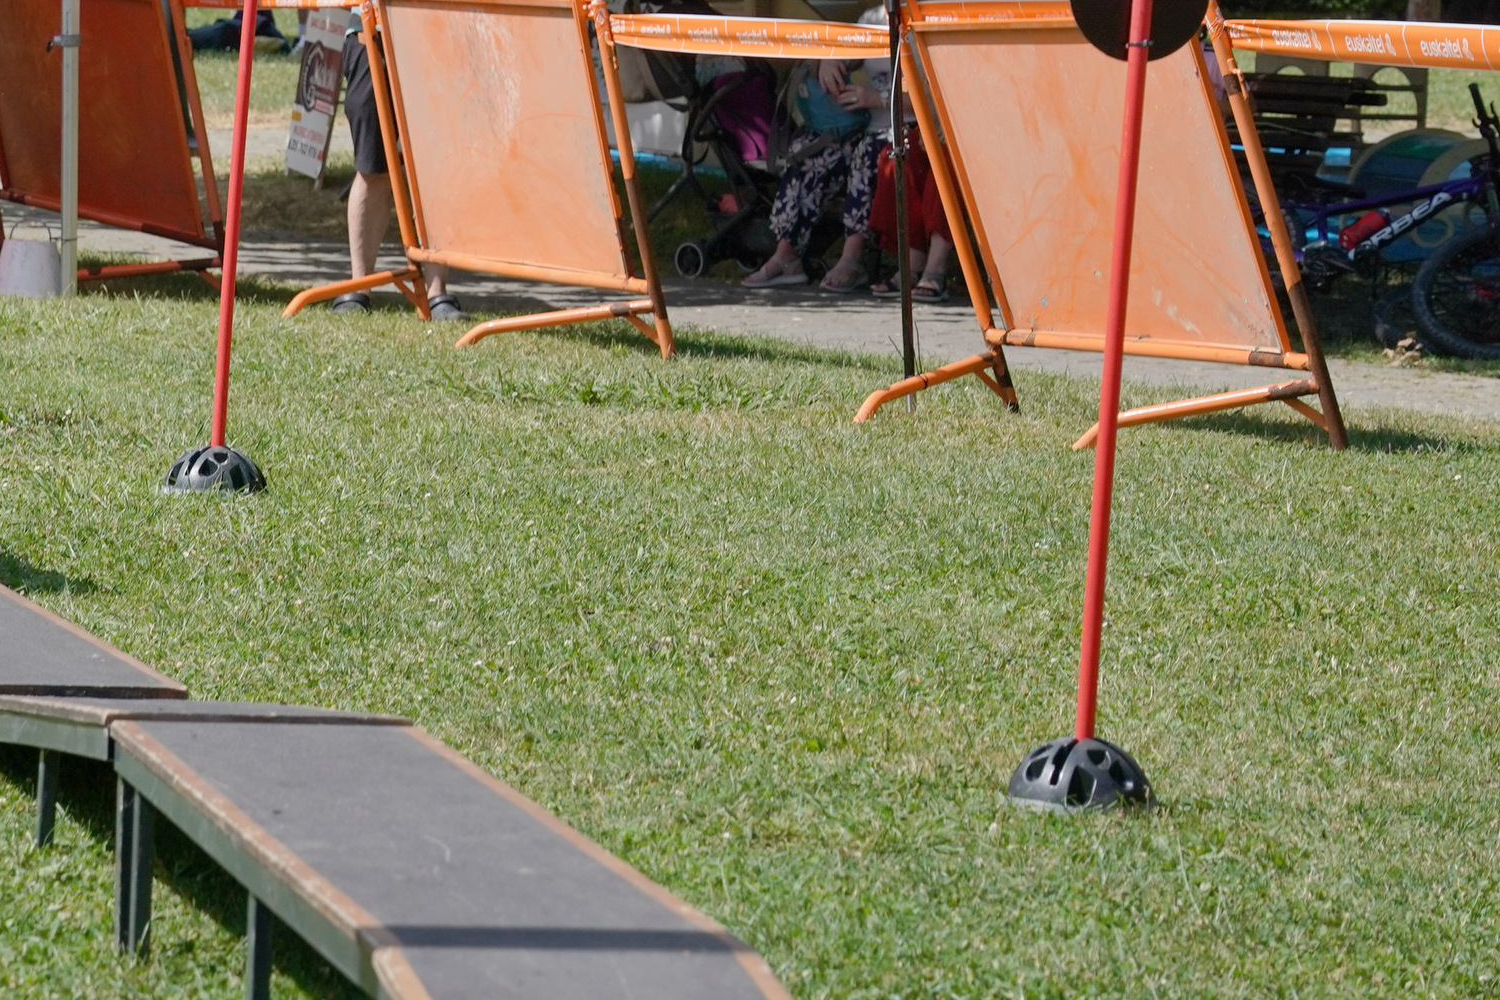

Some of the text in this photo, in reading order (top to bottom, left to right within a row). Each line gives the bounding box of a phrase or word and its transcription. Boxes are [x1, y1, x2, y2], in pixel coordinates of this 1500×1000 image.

[1271, 28, 1312, 49] euskaltel
[1344, 33, 1386, 54] euskaltel
[1420, 38, 1461, 59] euskaltel
